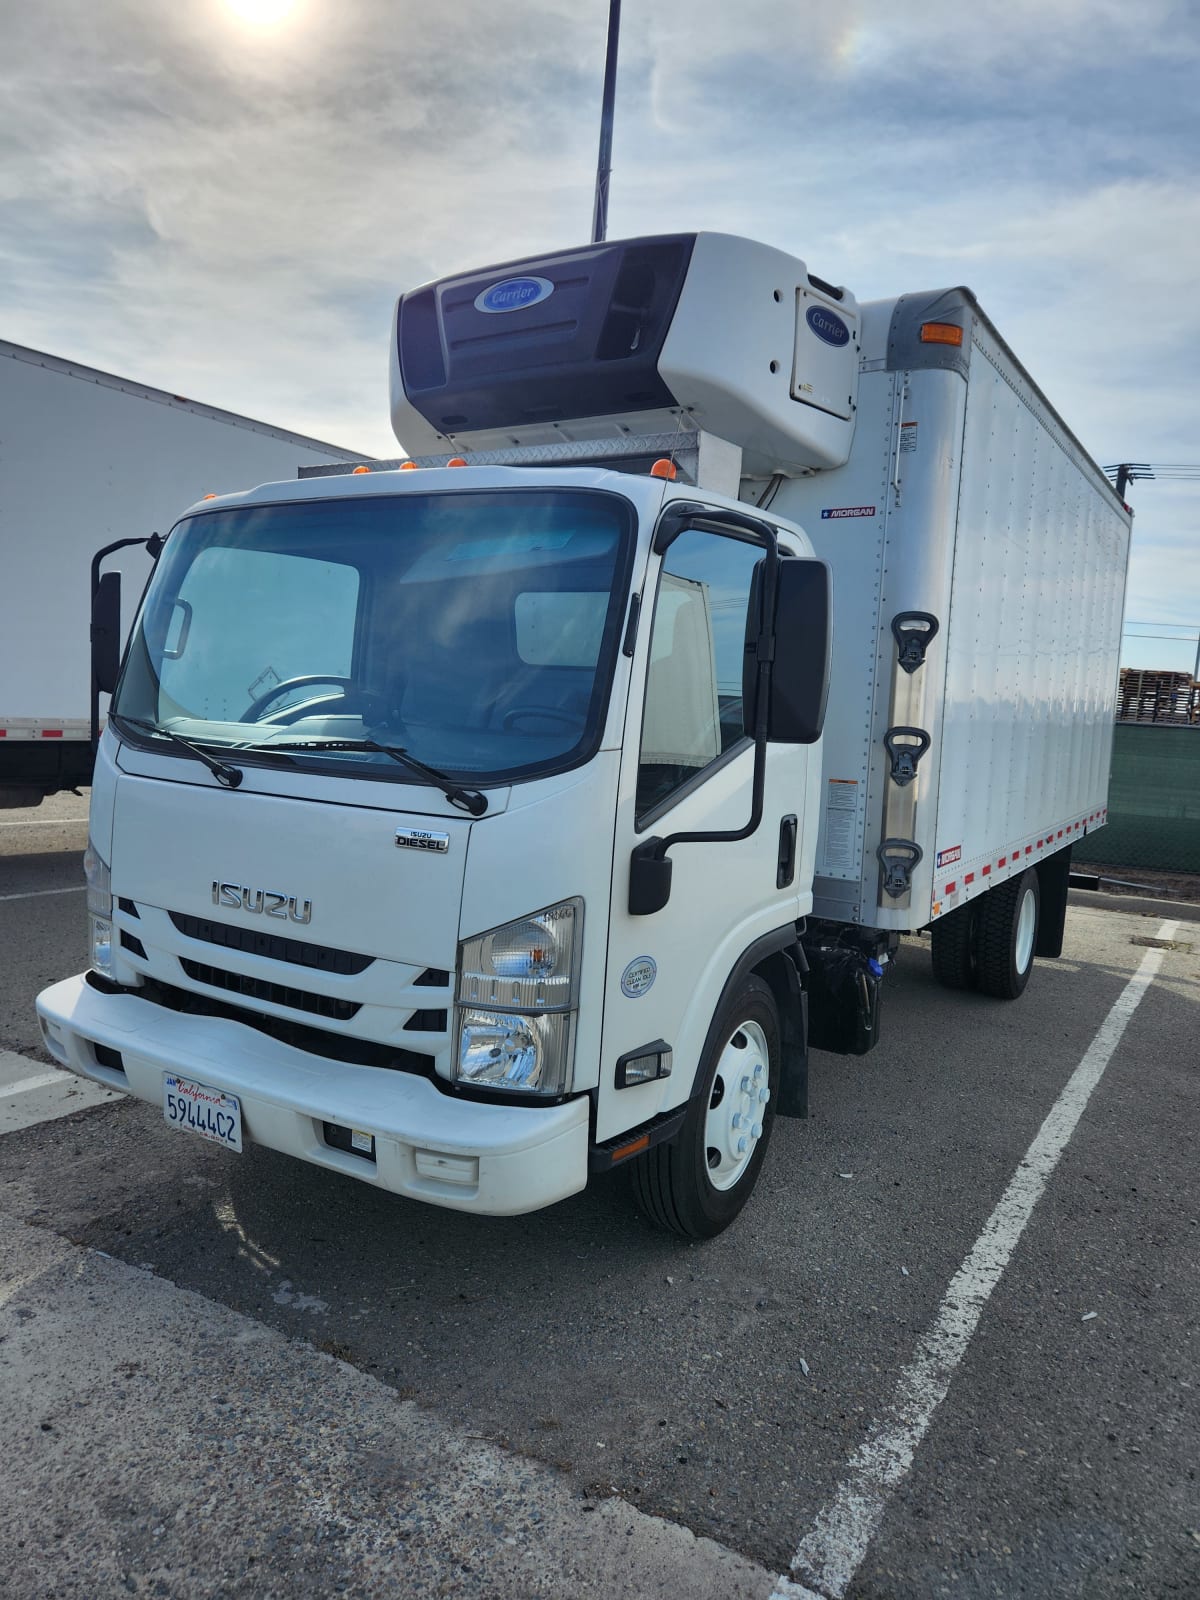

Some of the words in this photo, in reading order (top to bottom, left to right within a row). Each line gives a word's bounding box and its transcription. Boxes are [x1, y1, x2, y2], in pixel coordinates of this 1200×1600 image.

[492, 286, 534, 304] Carrier
[812, 312, 845, 338] Carrier
[830, 508, 874, 518] MORGAN
[410, 831, 432, 839] ISUZU
[396, 836, 446, 851] DIESEL
[211, 879, 312, 925] ISUZU
[628, 966, 651, 979] CERTIFIED
[626, 976, 642, 986] CLEAN
[177, 1081, 226, 1108] California
[167, 1093, 236, 1143] 59444C2
